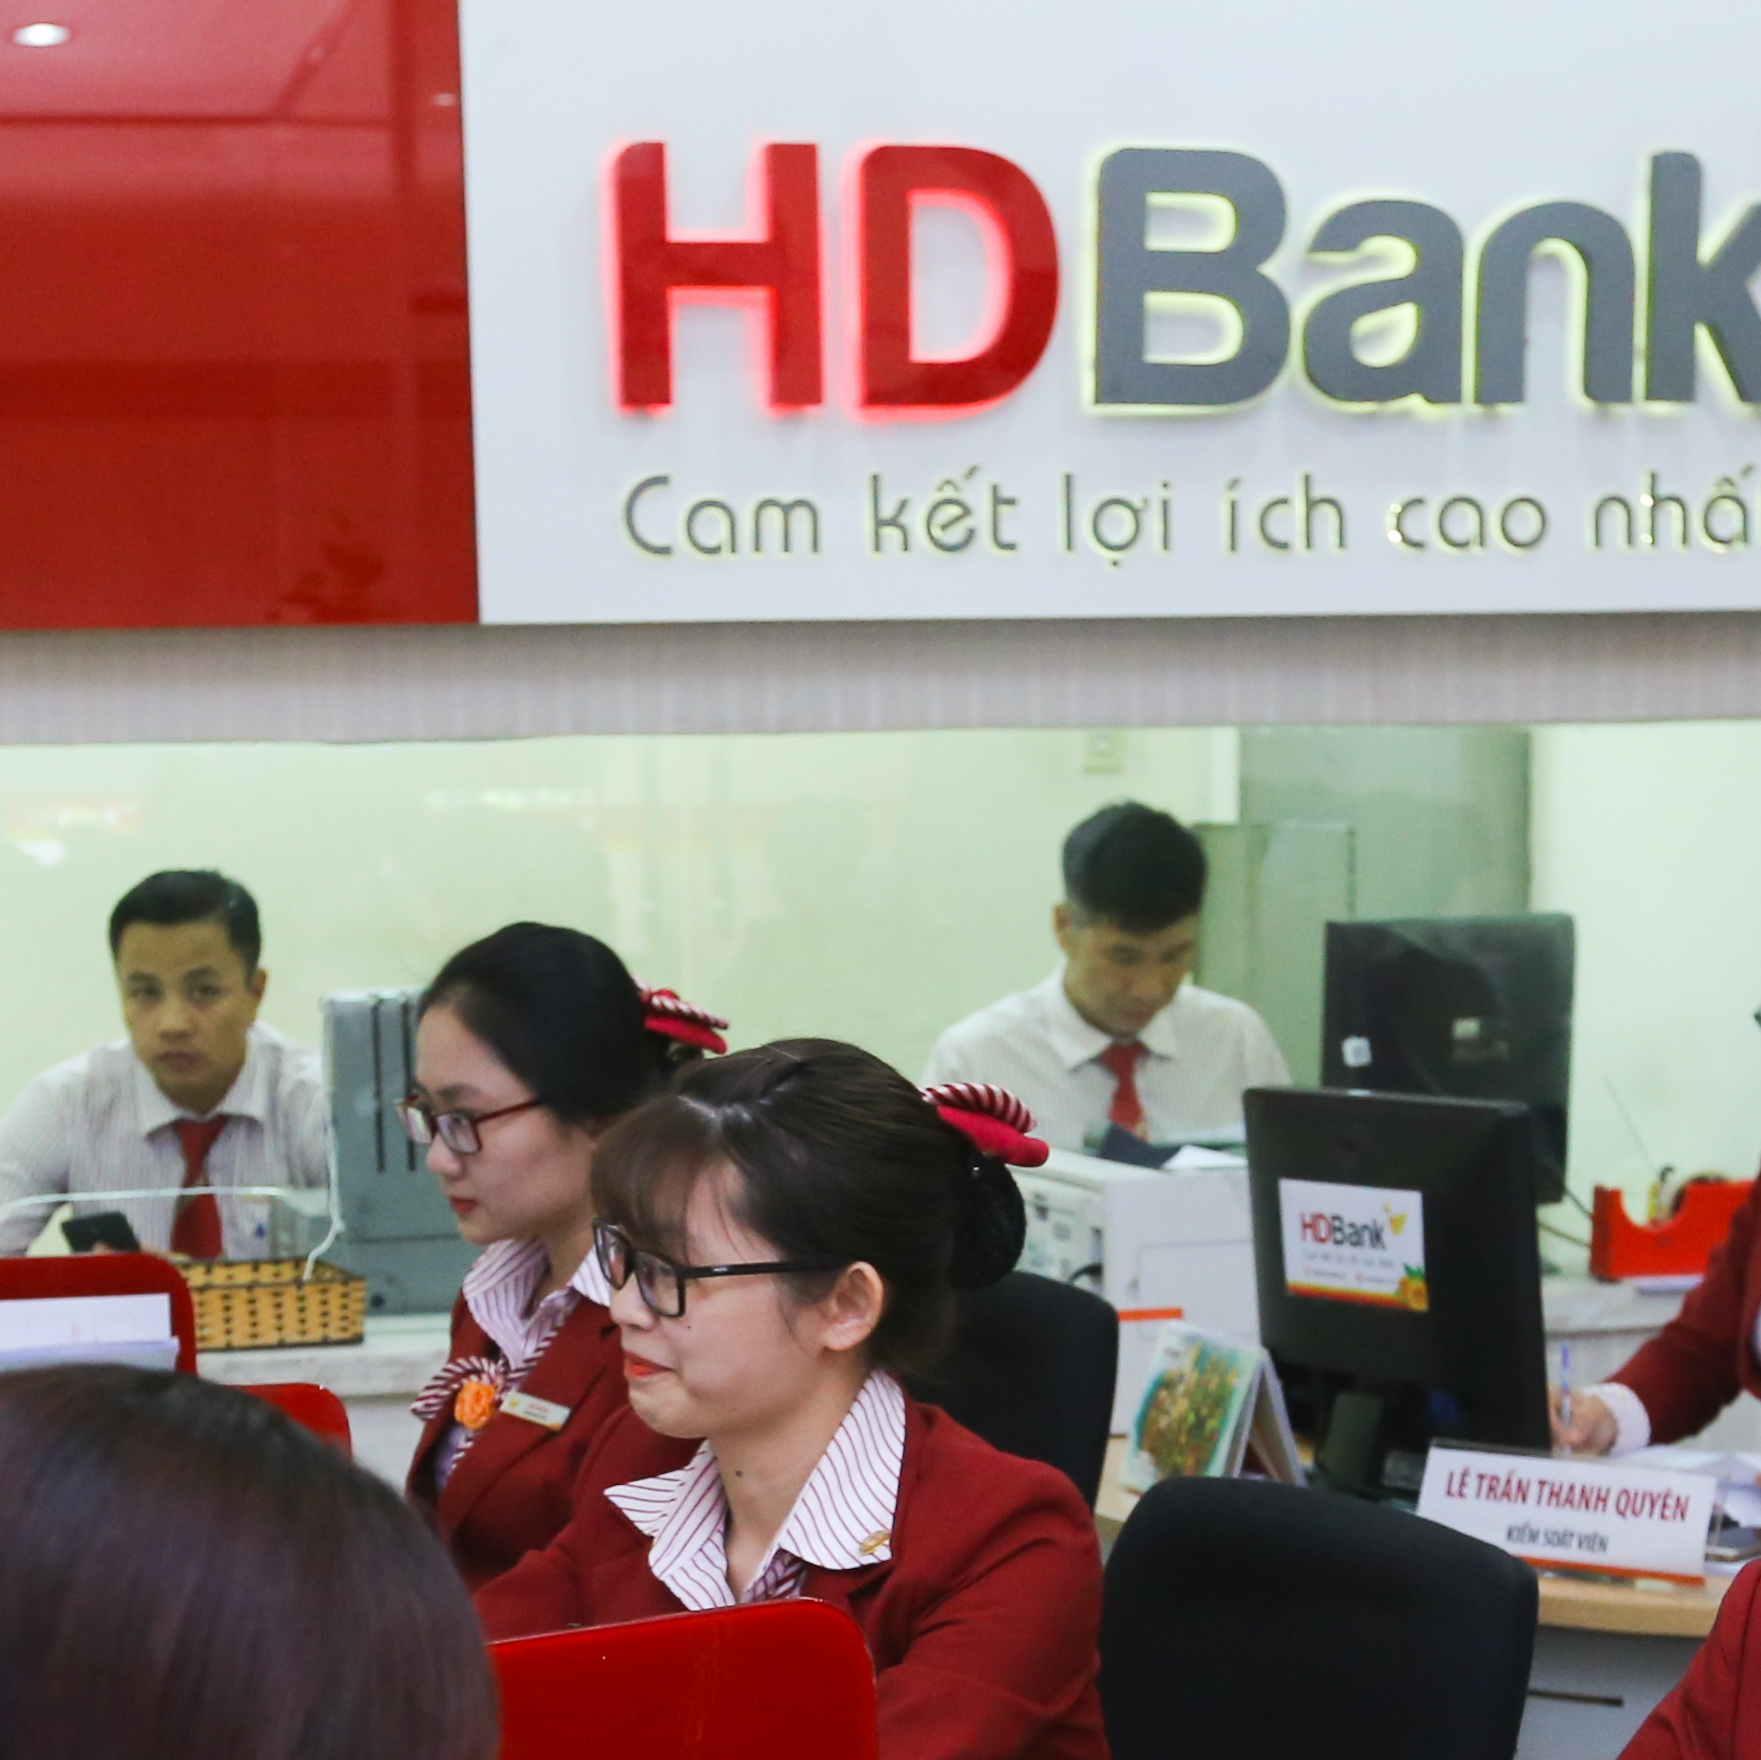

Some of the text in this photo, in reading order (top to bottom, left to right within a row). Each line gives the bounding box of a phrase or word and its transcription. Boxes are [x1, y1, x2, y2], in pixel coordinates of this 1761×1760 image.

[626, 475, 821, 555] Cam
[867, 467, 1018, 551] kết
[1062, 472, 1173, 568] lợi
[1225, 475, 1344, 551] ích
[1388, 492, 1547, 551] cao
[1300, 1212, 1386, 1250] HDBank
[1537, 1479, 1610, 1512] THANH
